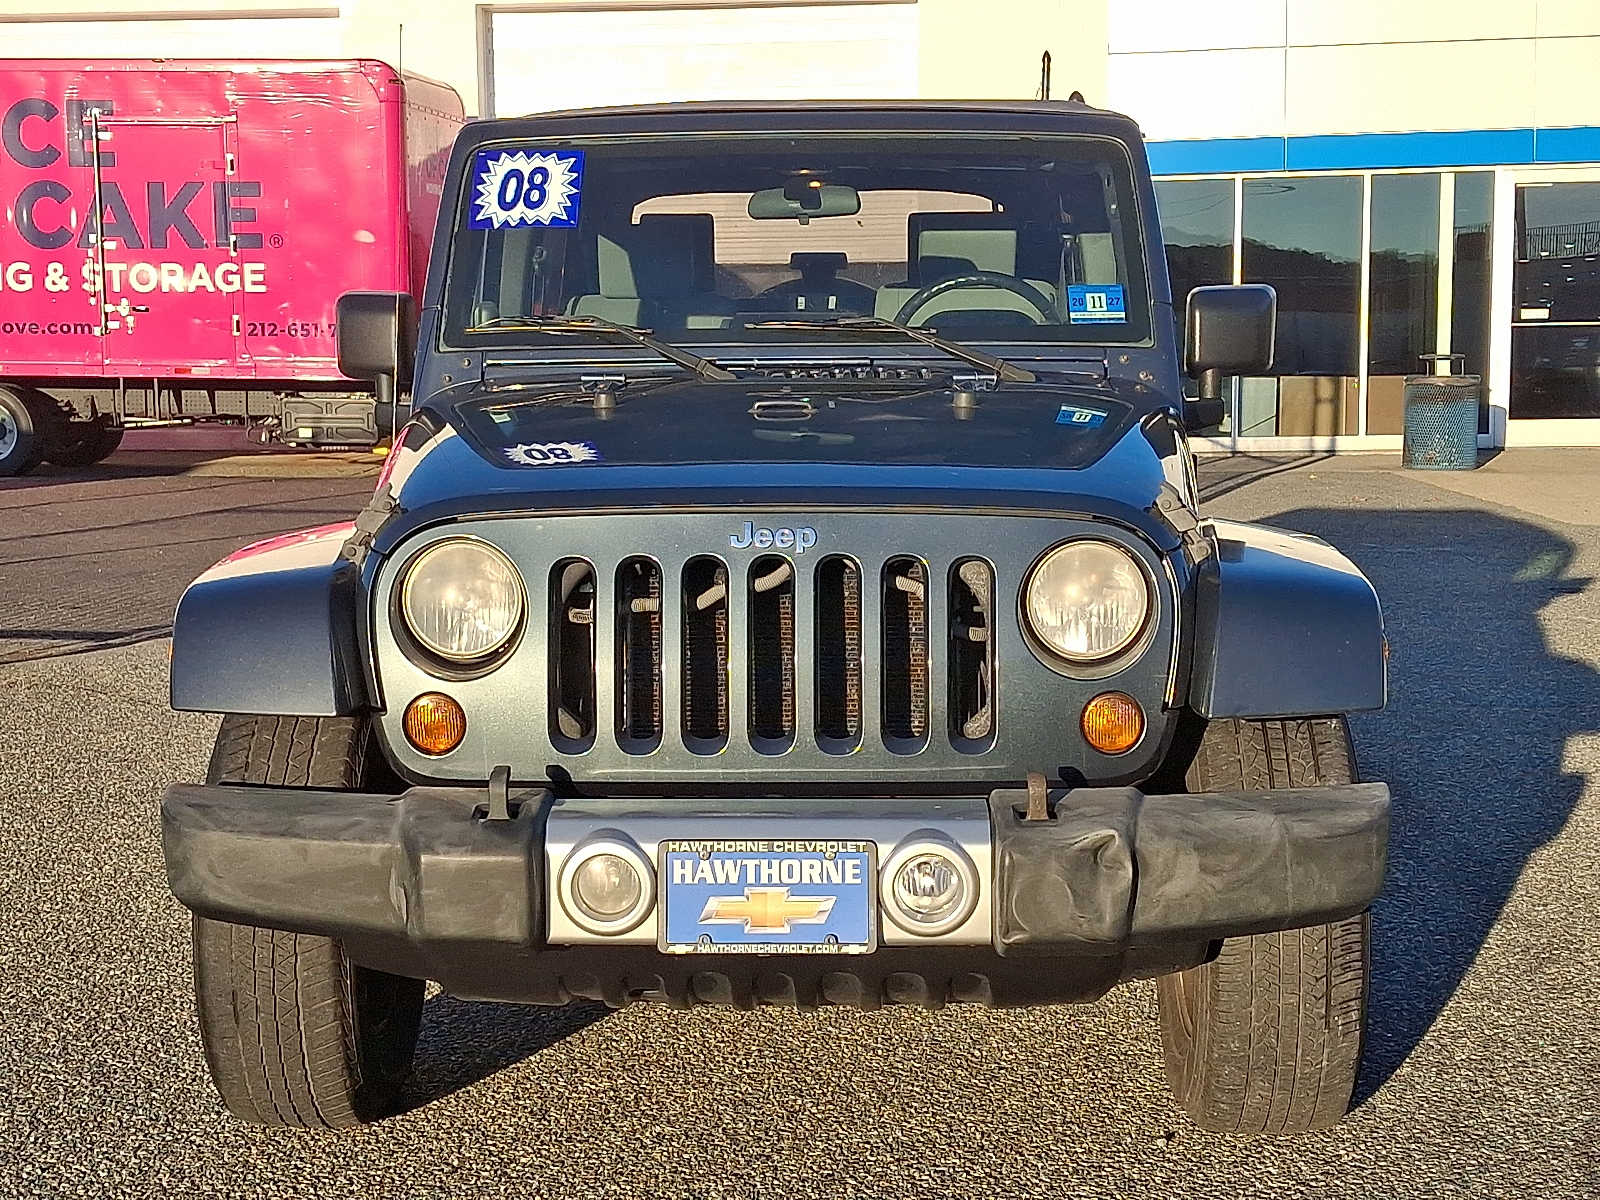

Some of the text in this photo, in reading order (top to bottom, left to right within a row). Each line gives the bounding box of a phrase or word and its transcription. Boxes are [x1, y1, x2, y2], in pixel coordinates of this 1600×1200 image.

[498, 166, 549, 211] 08
[44, 261, 70, 292] &
[82, 262, 267, 294] STORAGE
[1072, 295, 1121, 309] 20 11 27
[729, 520, 818, 554] Jeep
[668, 841, 867, 852] HAWTHORNE CHEVROLET
[672, 858, 863, 885] HAWTHORNE
[697, 943, 838, 954] HAWTHORNECHEVROLET.COM
